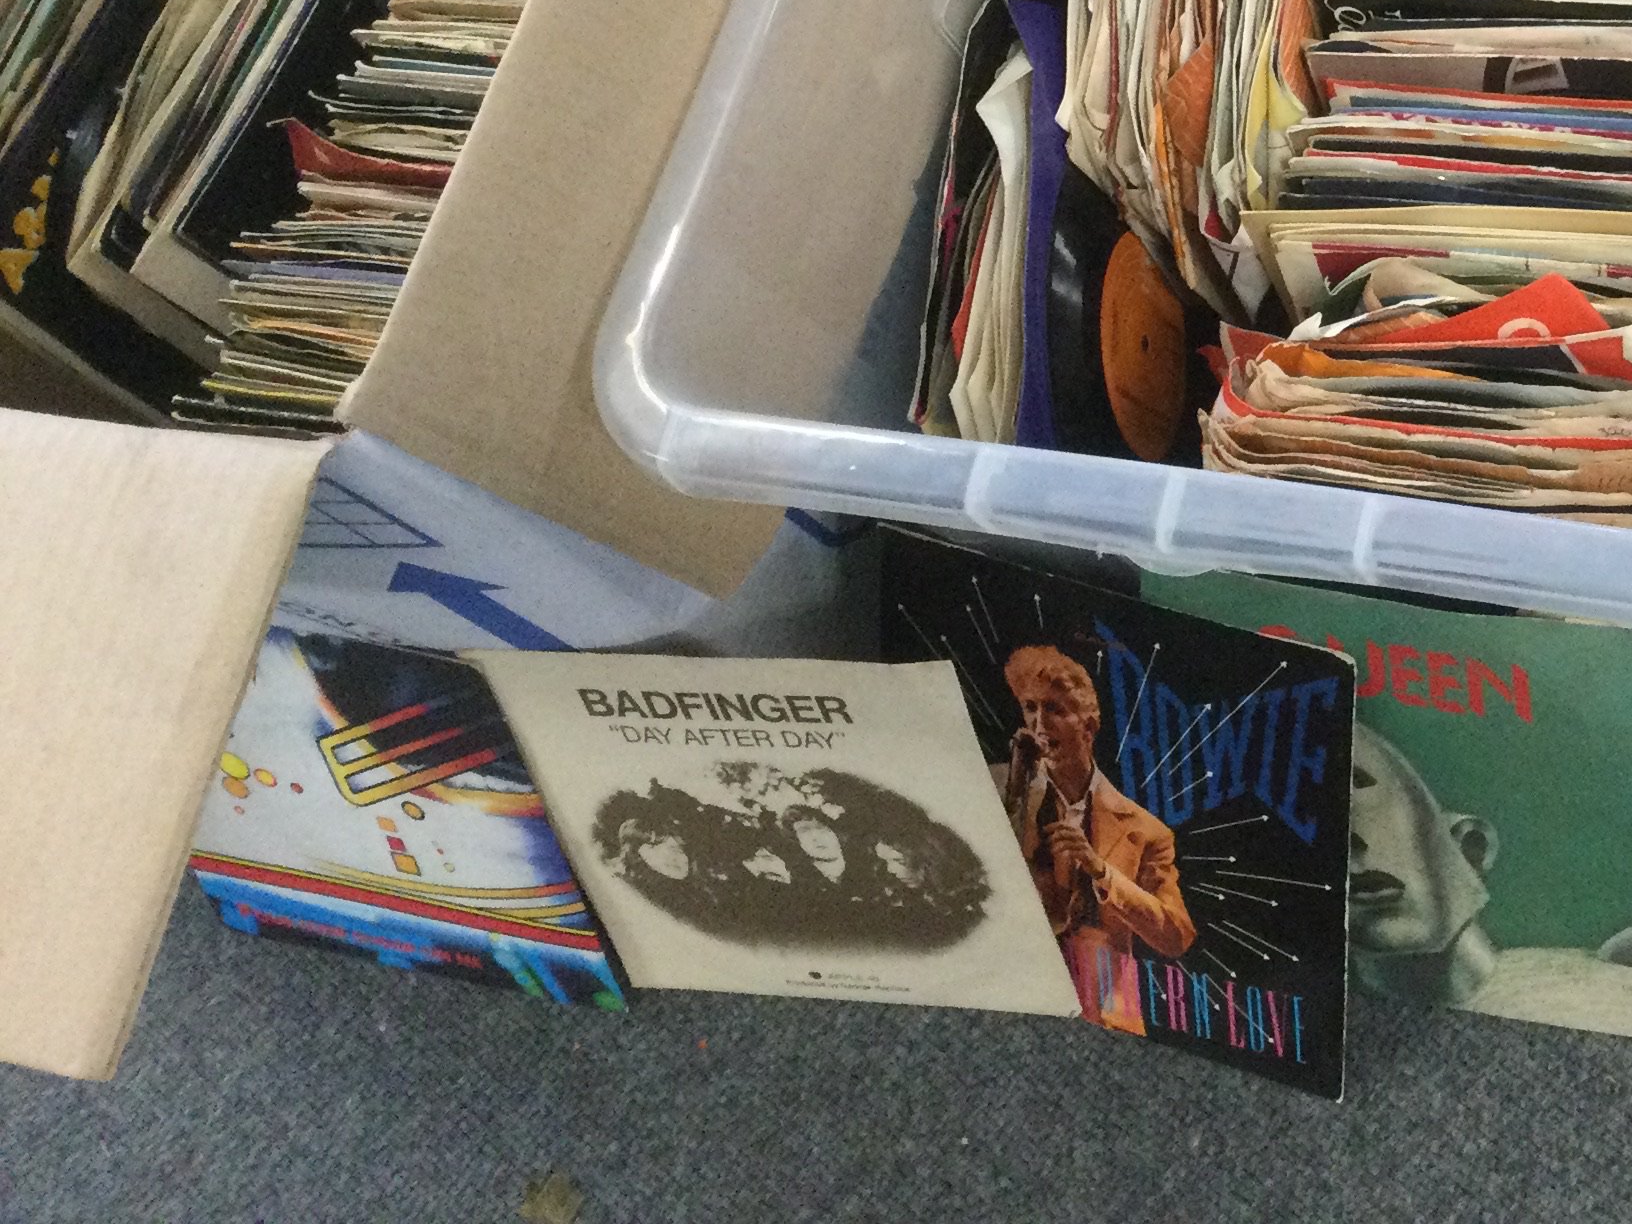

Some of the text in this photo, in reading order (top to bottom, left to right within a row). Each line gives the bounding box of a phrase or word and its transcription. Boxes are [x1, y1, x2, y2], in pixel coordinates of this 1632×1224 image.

[1257, 624, 1534, 724] UEEN
[576, 687, 854, 725] BADFINGER
[685, 728, 775, 748] AFTER
[1225, 981, 1307, 1064] LOVE
